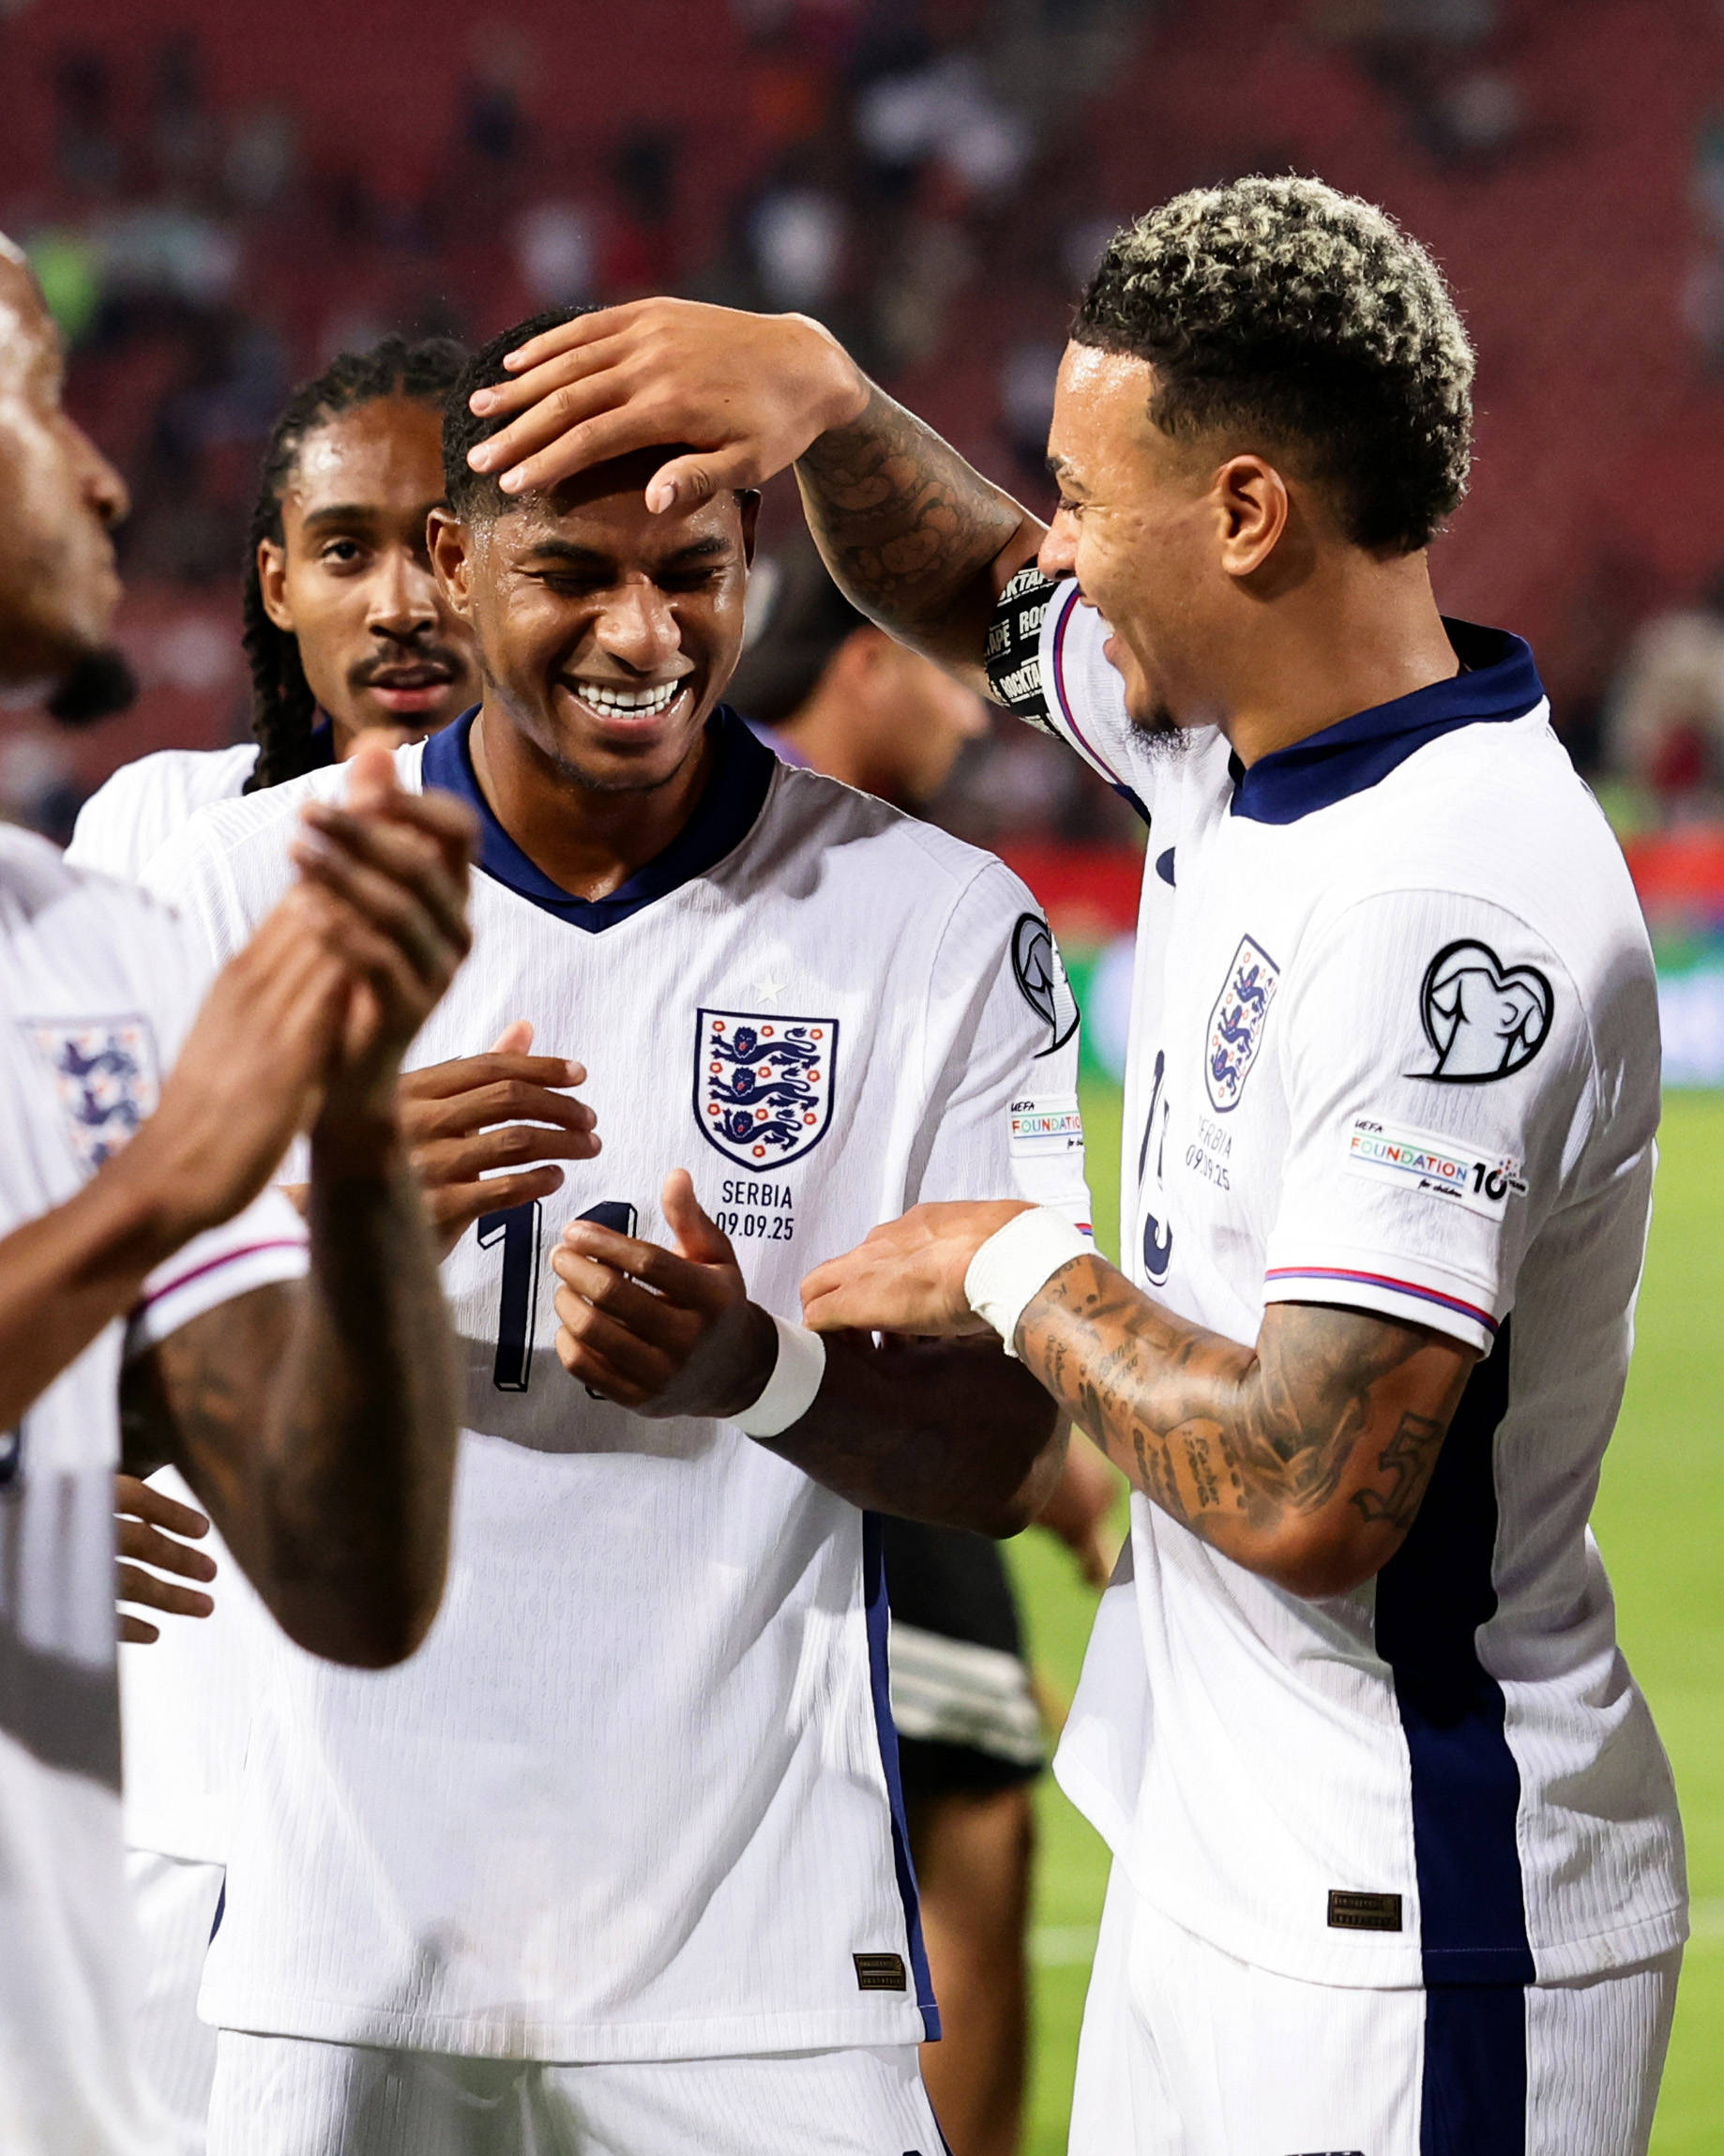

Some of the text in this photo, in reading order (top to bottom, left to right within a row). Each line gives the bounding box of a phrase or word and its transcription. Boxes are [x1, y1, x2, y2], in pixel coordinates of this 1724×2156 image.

[1011, 1101, 1035, 1112] UEFA
[1351, 1137, 1467, 1181] FOUNDATION
[722, 1180, 792, 1209] SERBIA
[717, 1211, 794, 1240] 09.09.25
